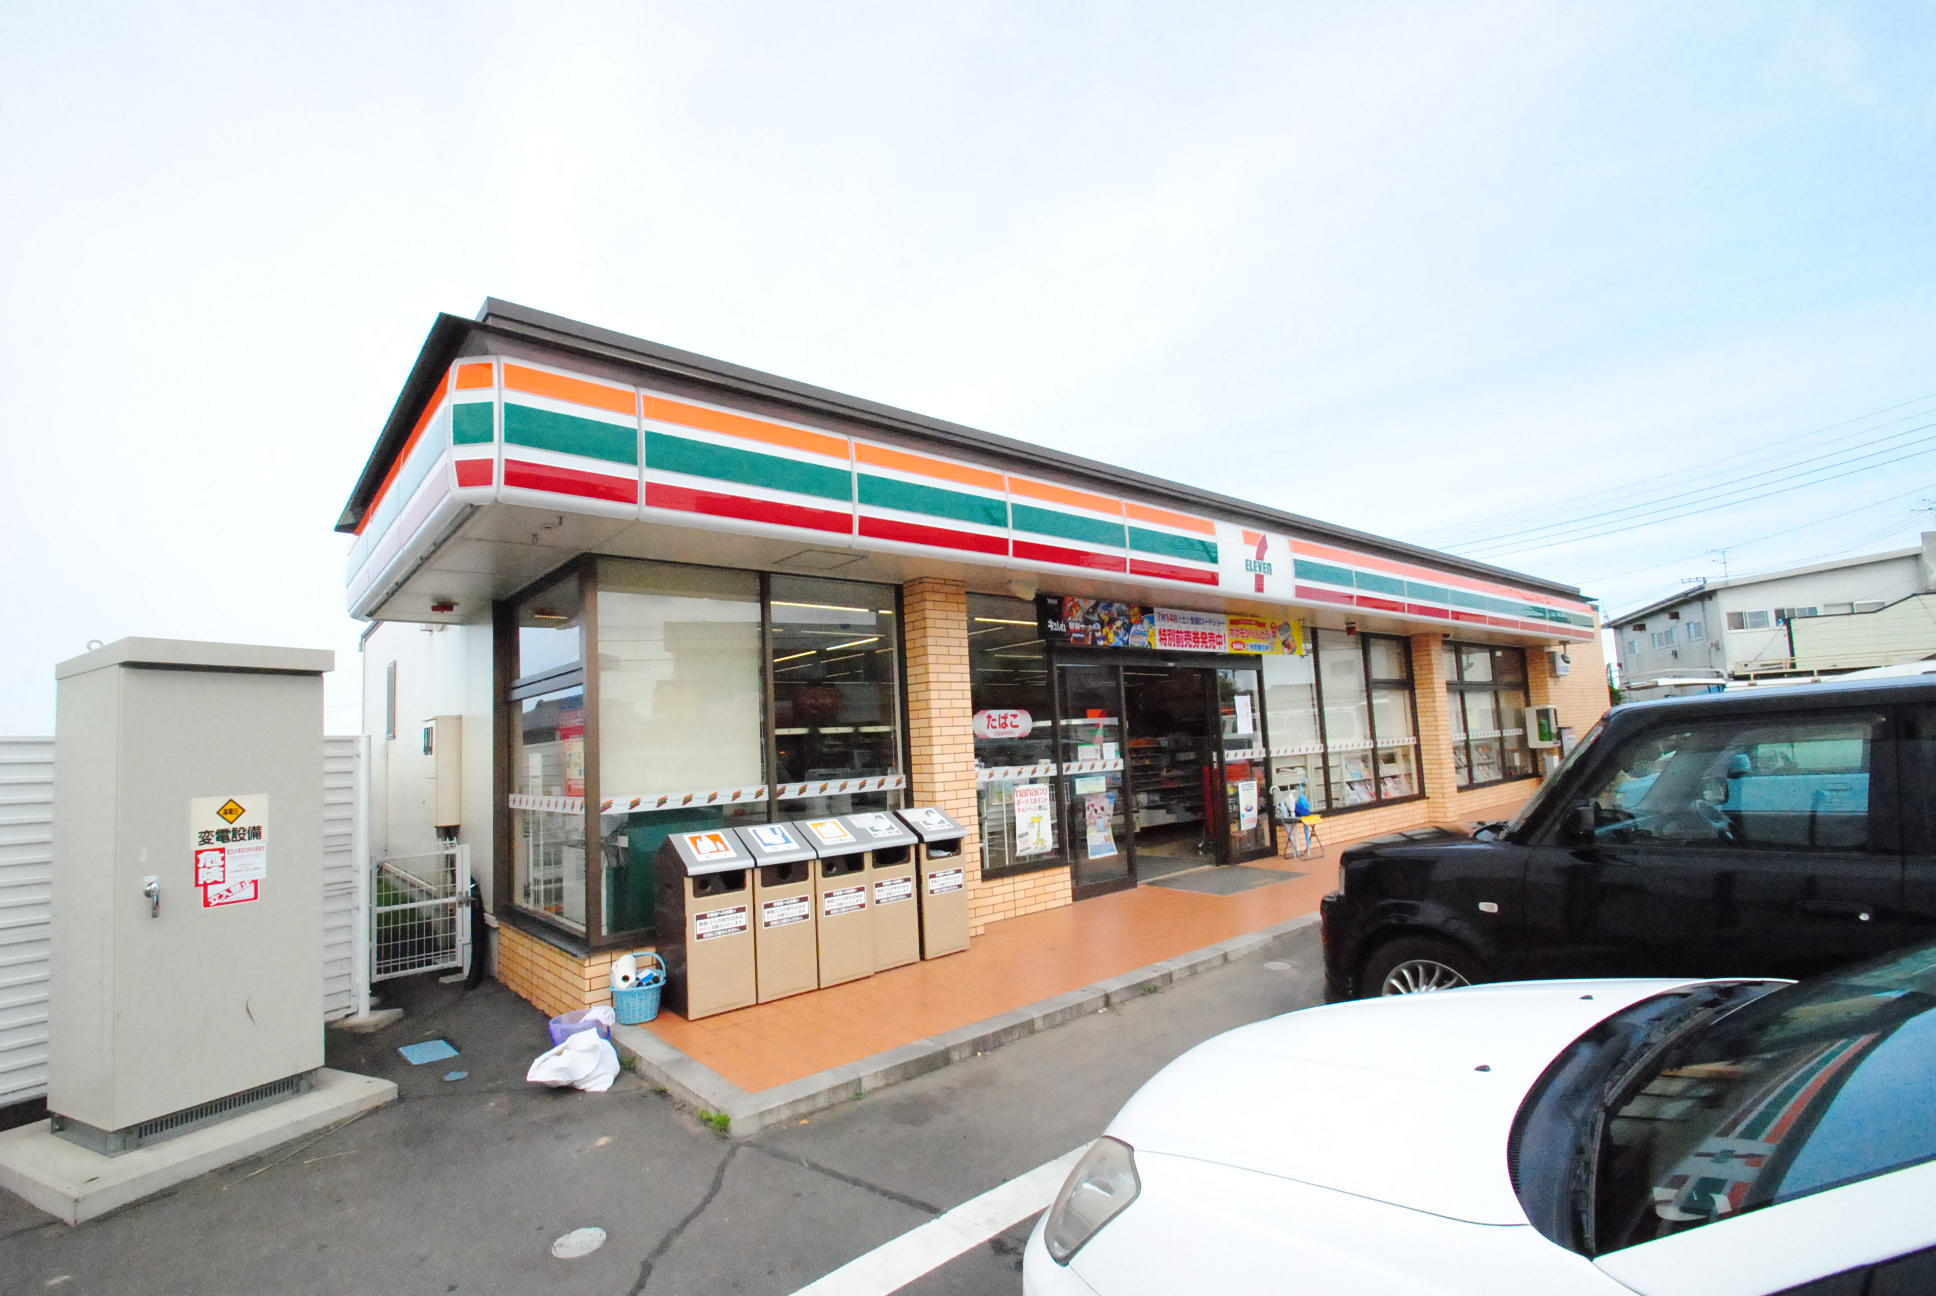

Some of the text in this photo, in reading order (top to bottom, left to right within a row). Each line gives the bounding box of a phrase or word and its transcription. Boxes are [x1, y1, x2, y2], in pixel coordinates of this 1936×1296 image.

[986, 713, 1020, 729] たばこ
[1015, 786, 1048, 798] nanaco
[198, 825, 263, 847] 変電設備
